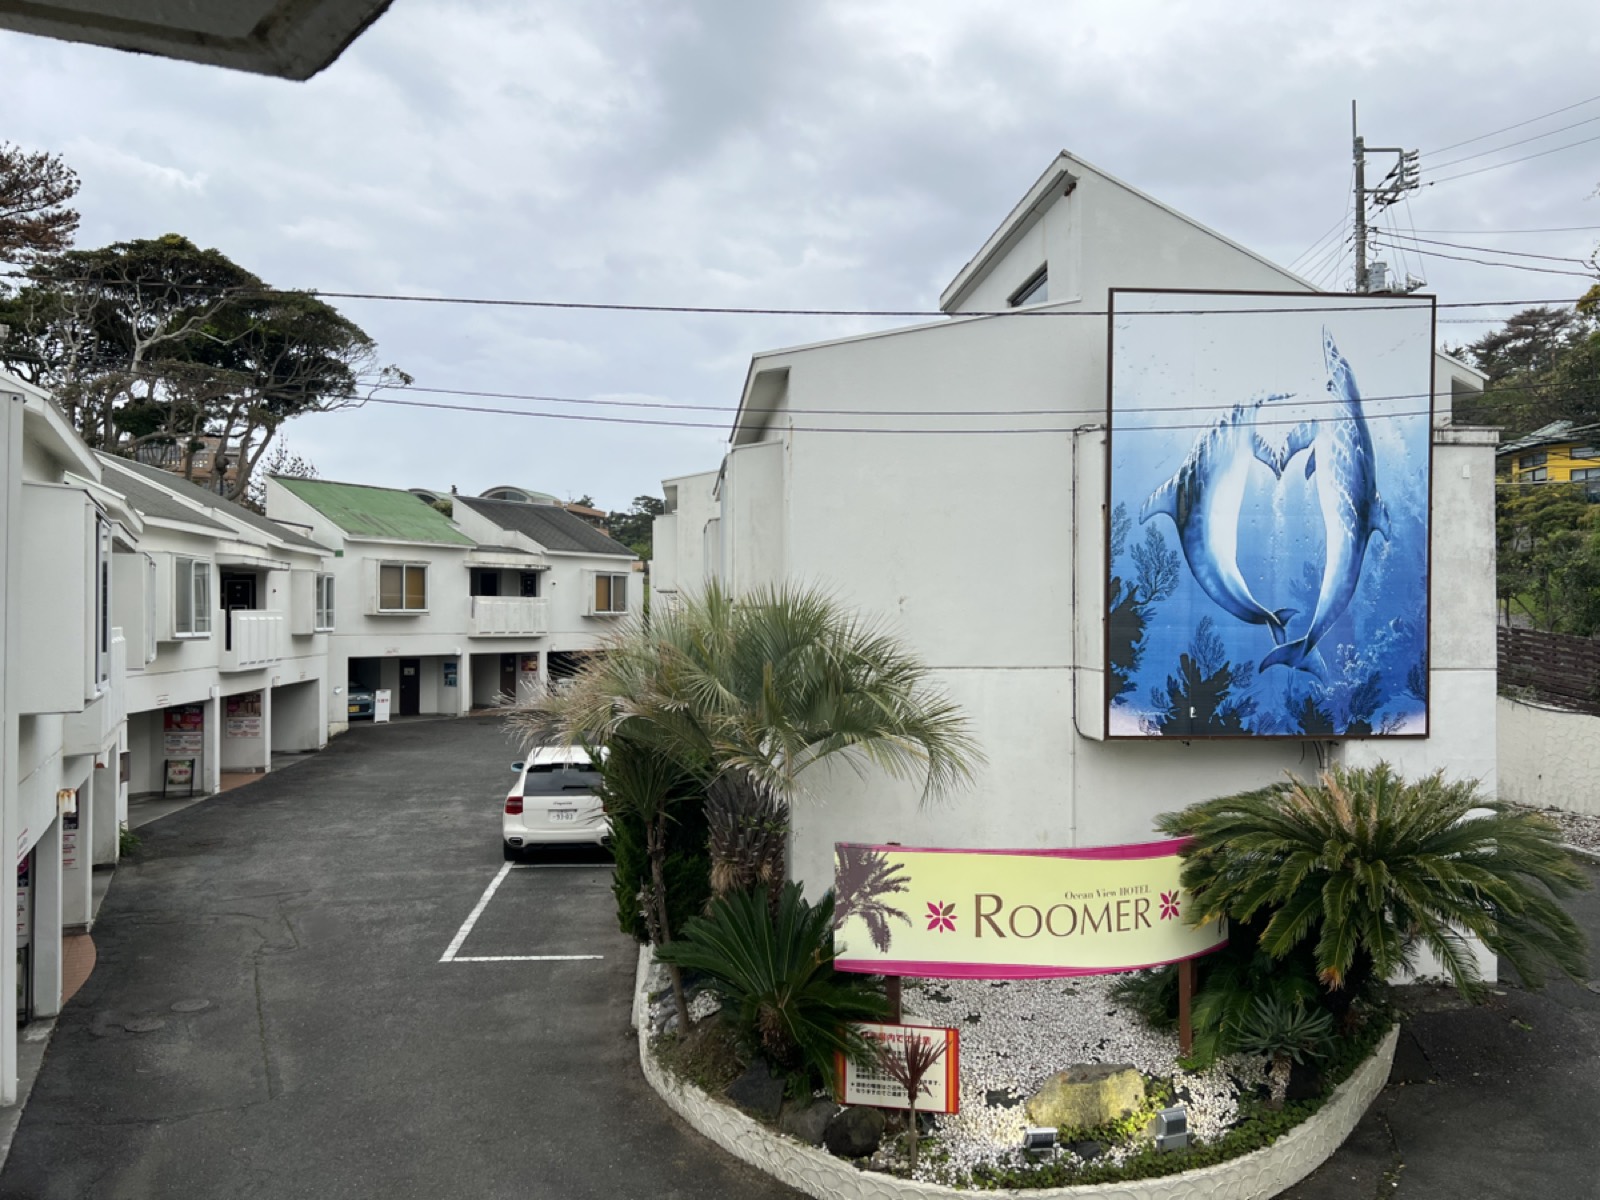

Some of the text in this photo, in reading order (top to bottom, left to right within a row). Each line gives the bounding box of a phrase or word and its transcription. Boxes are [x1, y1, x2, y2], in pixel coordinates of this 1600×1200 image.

[1064, 884, 1152, 900] Ocean View HOTEL
[975, 893, 1153, 940] ROOMER
